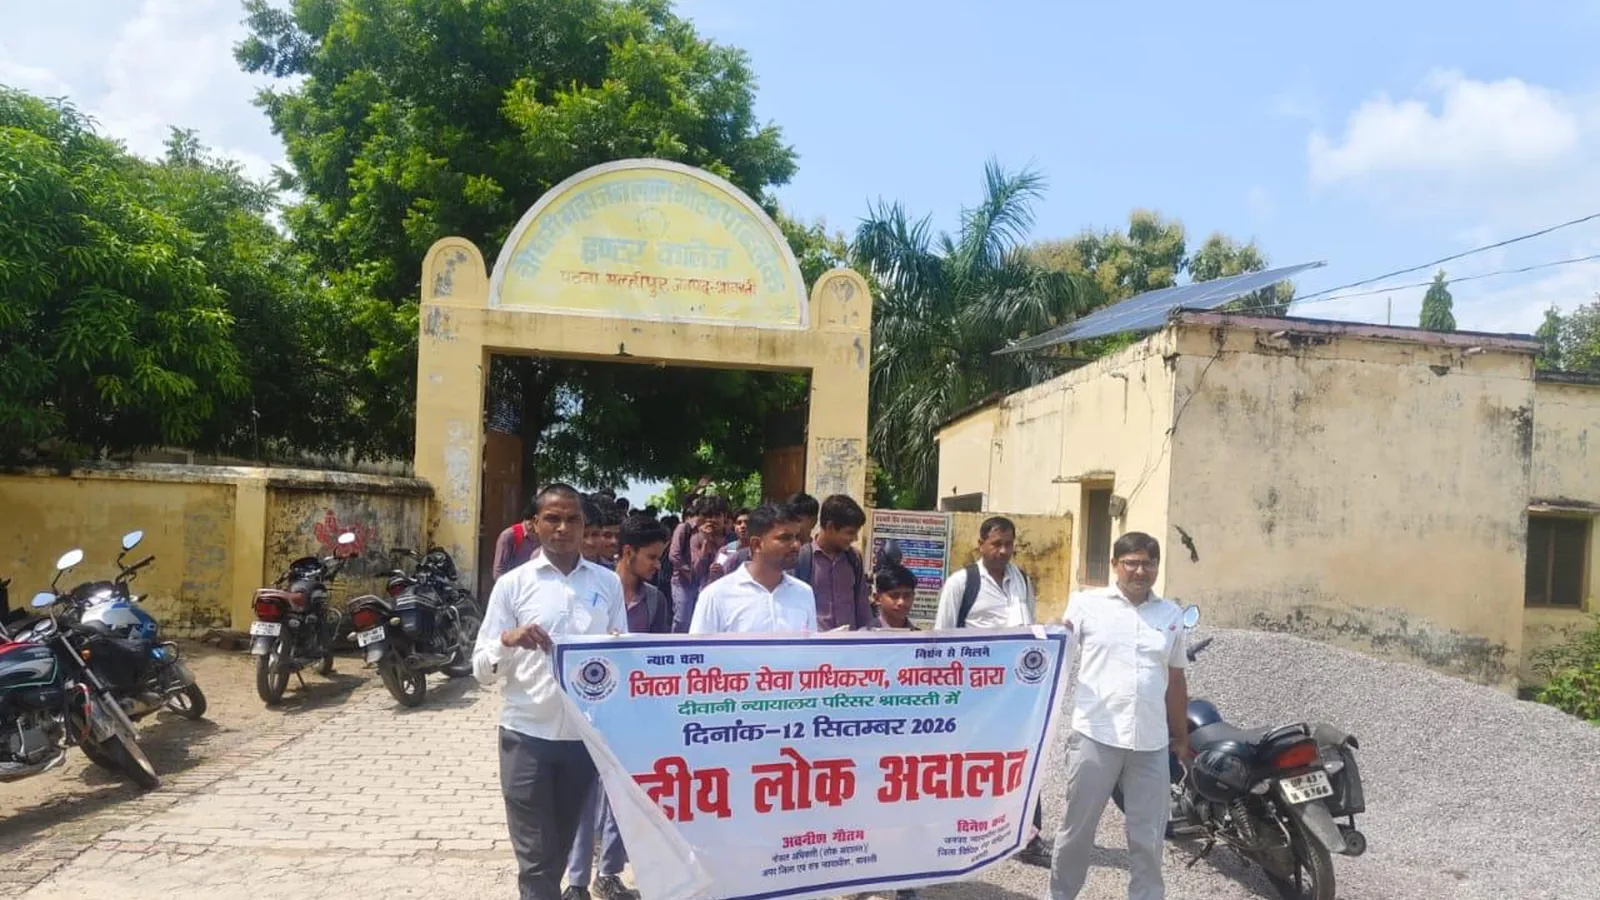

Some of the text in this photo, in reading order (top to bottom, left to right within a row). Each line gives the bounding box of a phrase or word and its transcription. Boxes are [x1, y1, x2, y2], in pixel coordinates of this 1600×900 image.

[646, 653, 704, 666] न्याय चला
[961, 645, 990, 657] मिलने
[630, 670, 680, 697] जिला
[687, 667, 750, 695] विधिक
[755, 666, 794, 691] सेवा
[799, 663, 890, 692] प्राधिकरण,
[897, 660, 964, 686] श्रावस्ती
[969, 666, 1005, 688] द्वारा
[678, 690, 961, 715] दीवानी न्यायालय परिसर श्रावस्ती में
[683, 715, 956, 746] दिनांक-12 सितम्बर 2026
[751, 747, 856, 813] लोक
[877, 748, 1029, 804] अदालत
[832, 829, 864, 842] गौतम
